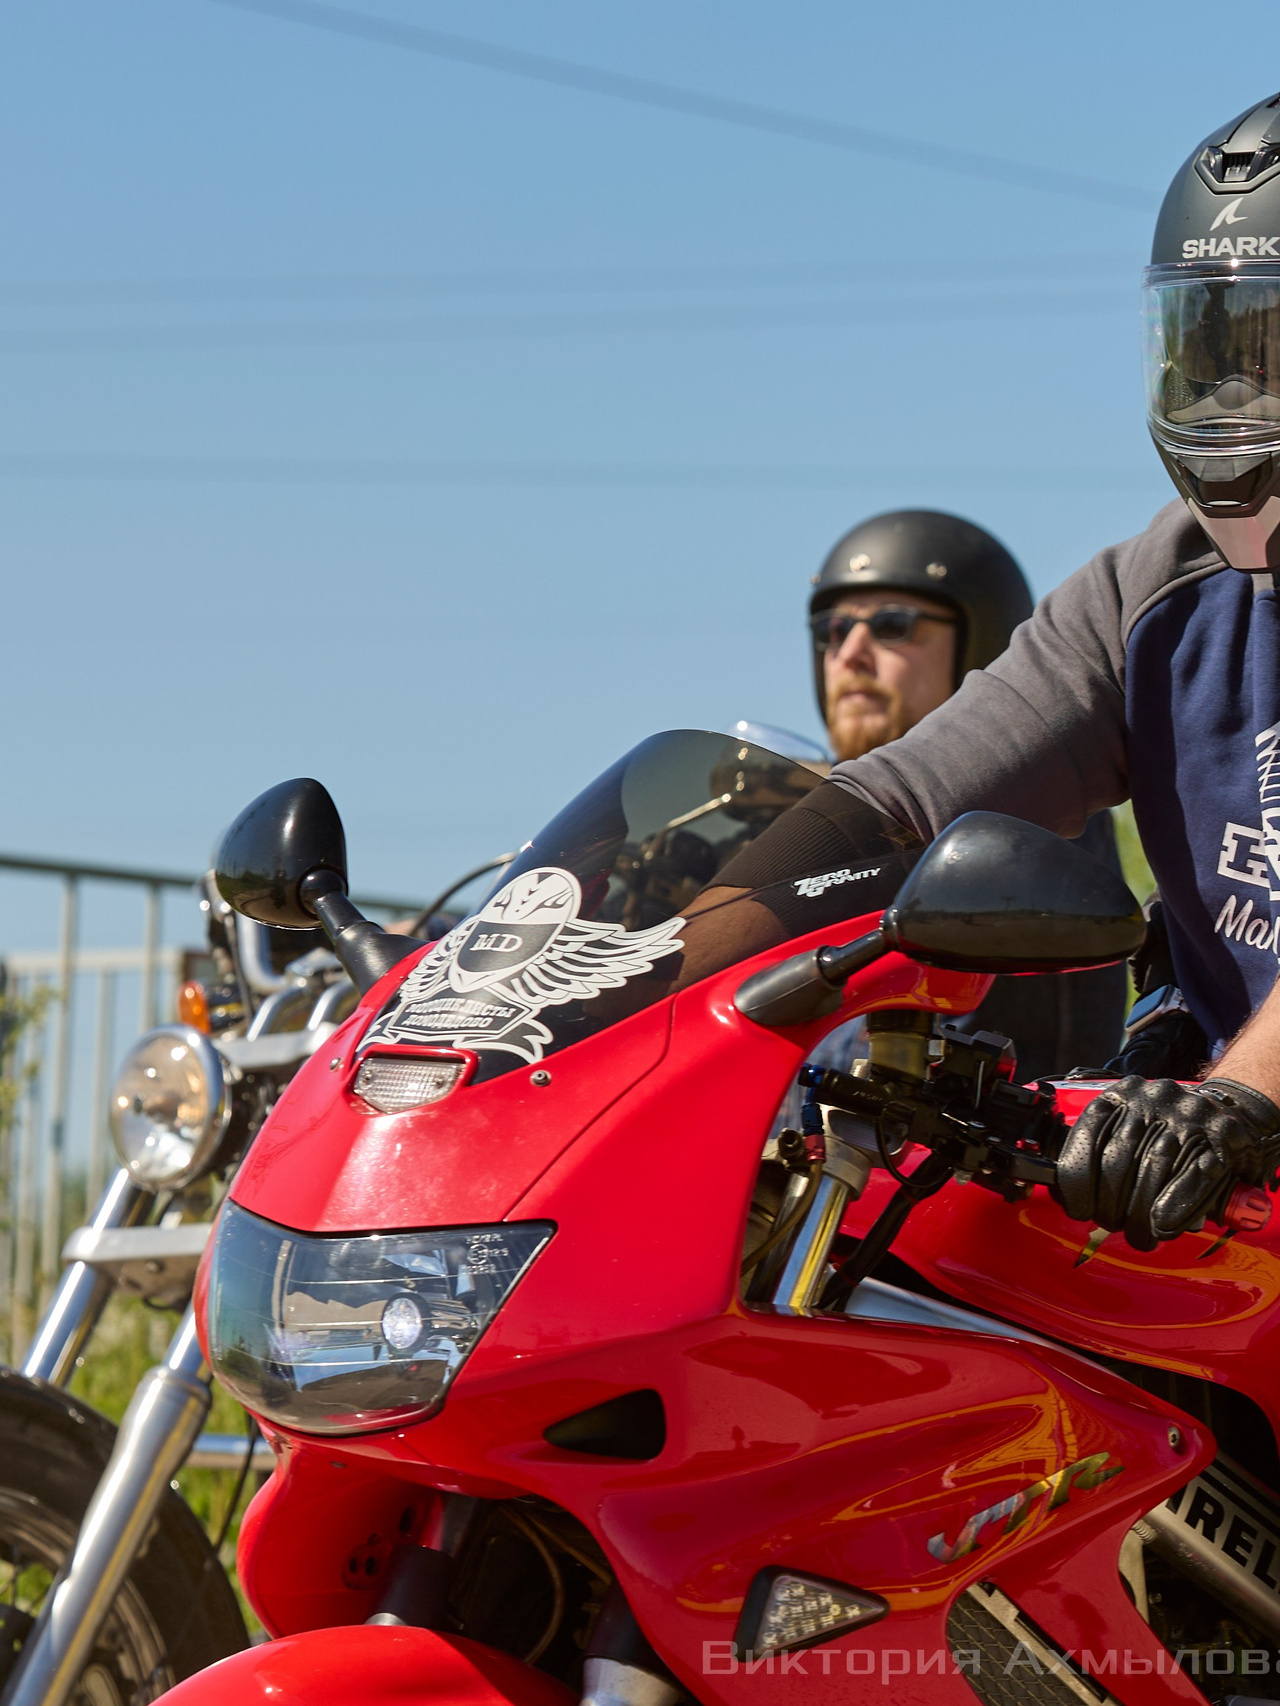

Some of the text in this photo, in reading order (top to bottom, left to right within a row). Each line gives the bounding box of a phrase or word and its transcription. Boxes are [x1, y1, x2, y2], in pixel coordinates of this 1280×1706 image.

[1182, 236, 1280, 259] SHARK
[793, 868, 851, 896] ZERO
[806, 867, 881, 898] GRAVITY
[469, 933, 523, 952] MD
